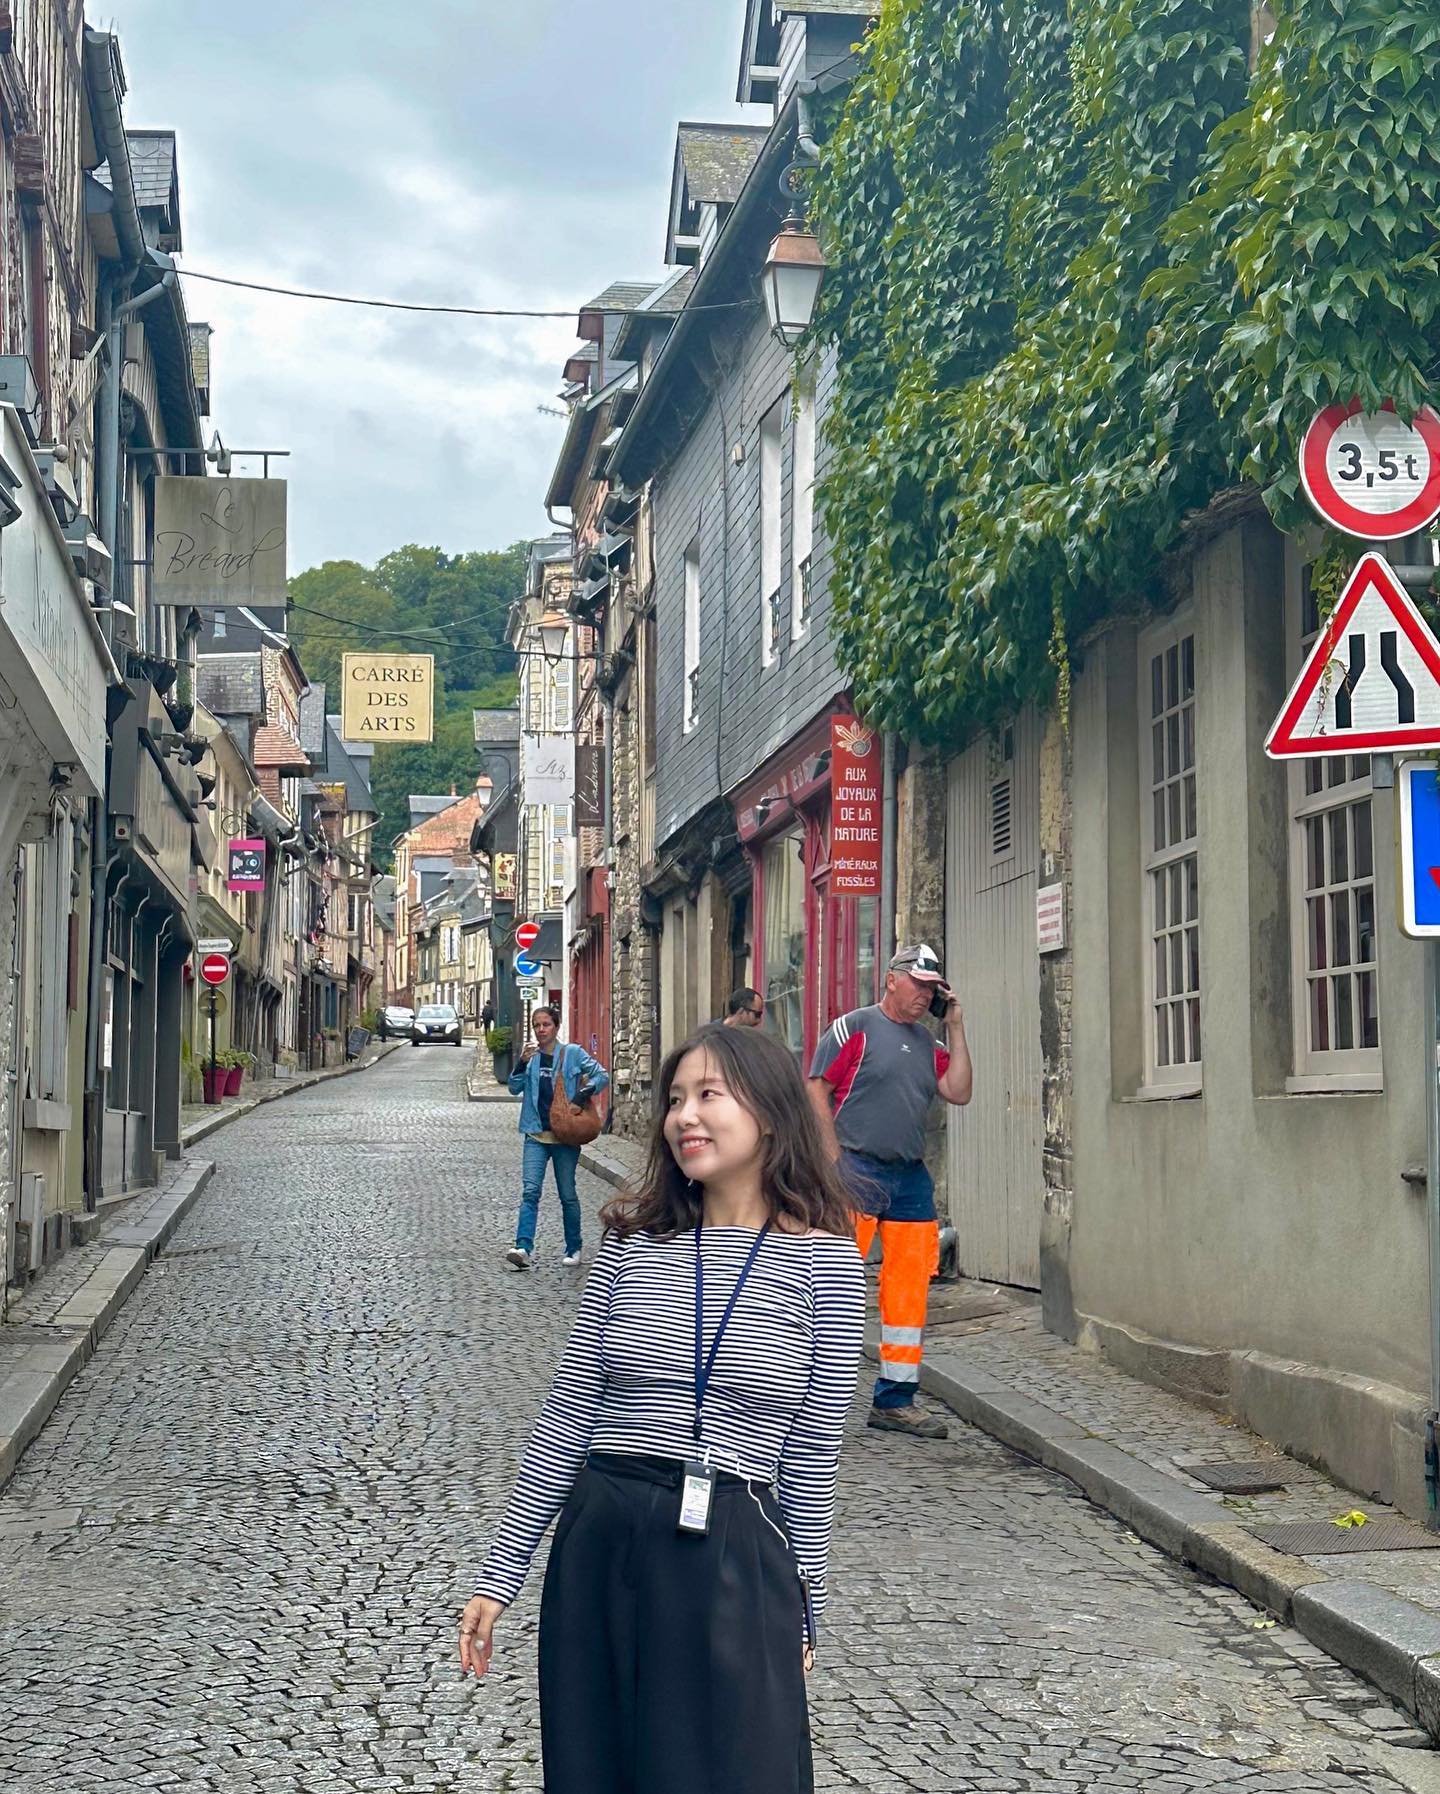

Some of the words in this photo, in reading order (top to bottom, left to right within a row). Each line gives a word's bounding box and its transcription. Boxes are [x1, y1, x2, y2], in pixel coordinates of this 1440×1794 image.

[200, 487, 243, 534] Le
[156, 527, 285, 578] Bréard
[352, 665, 424, 683] CARRÉ
[367, 692, 409, 707] DES
[360, 716, 416, 731] ARTS
[845, 767, 867, 781] AUX
[835, 787, 877, 801] JOYAUX
[840, 807, 855, 821] DE
[858, 807, 872, 821] LA
[834, 827, 879, 841] NATURE
